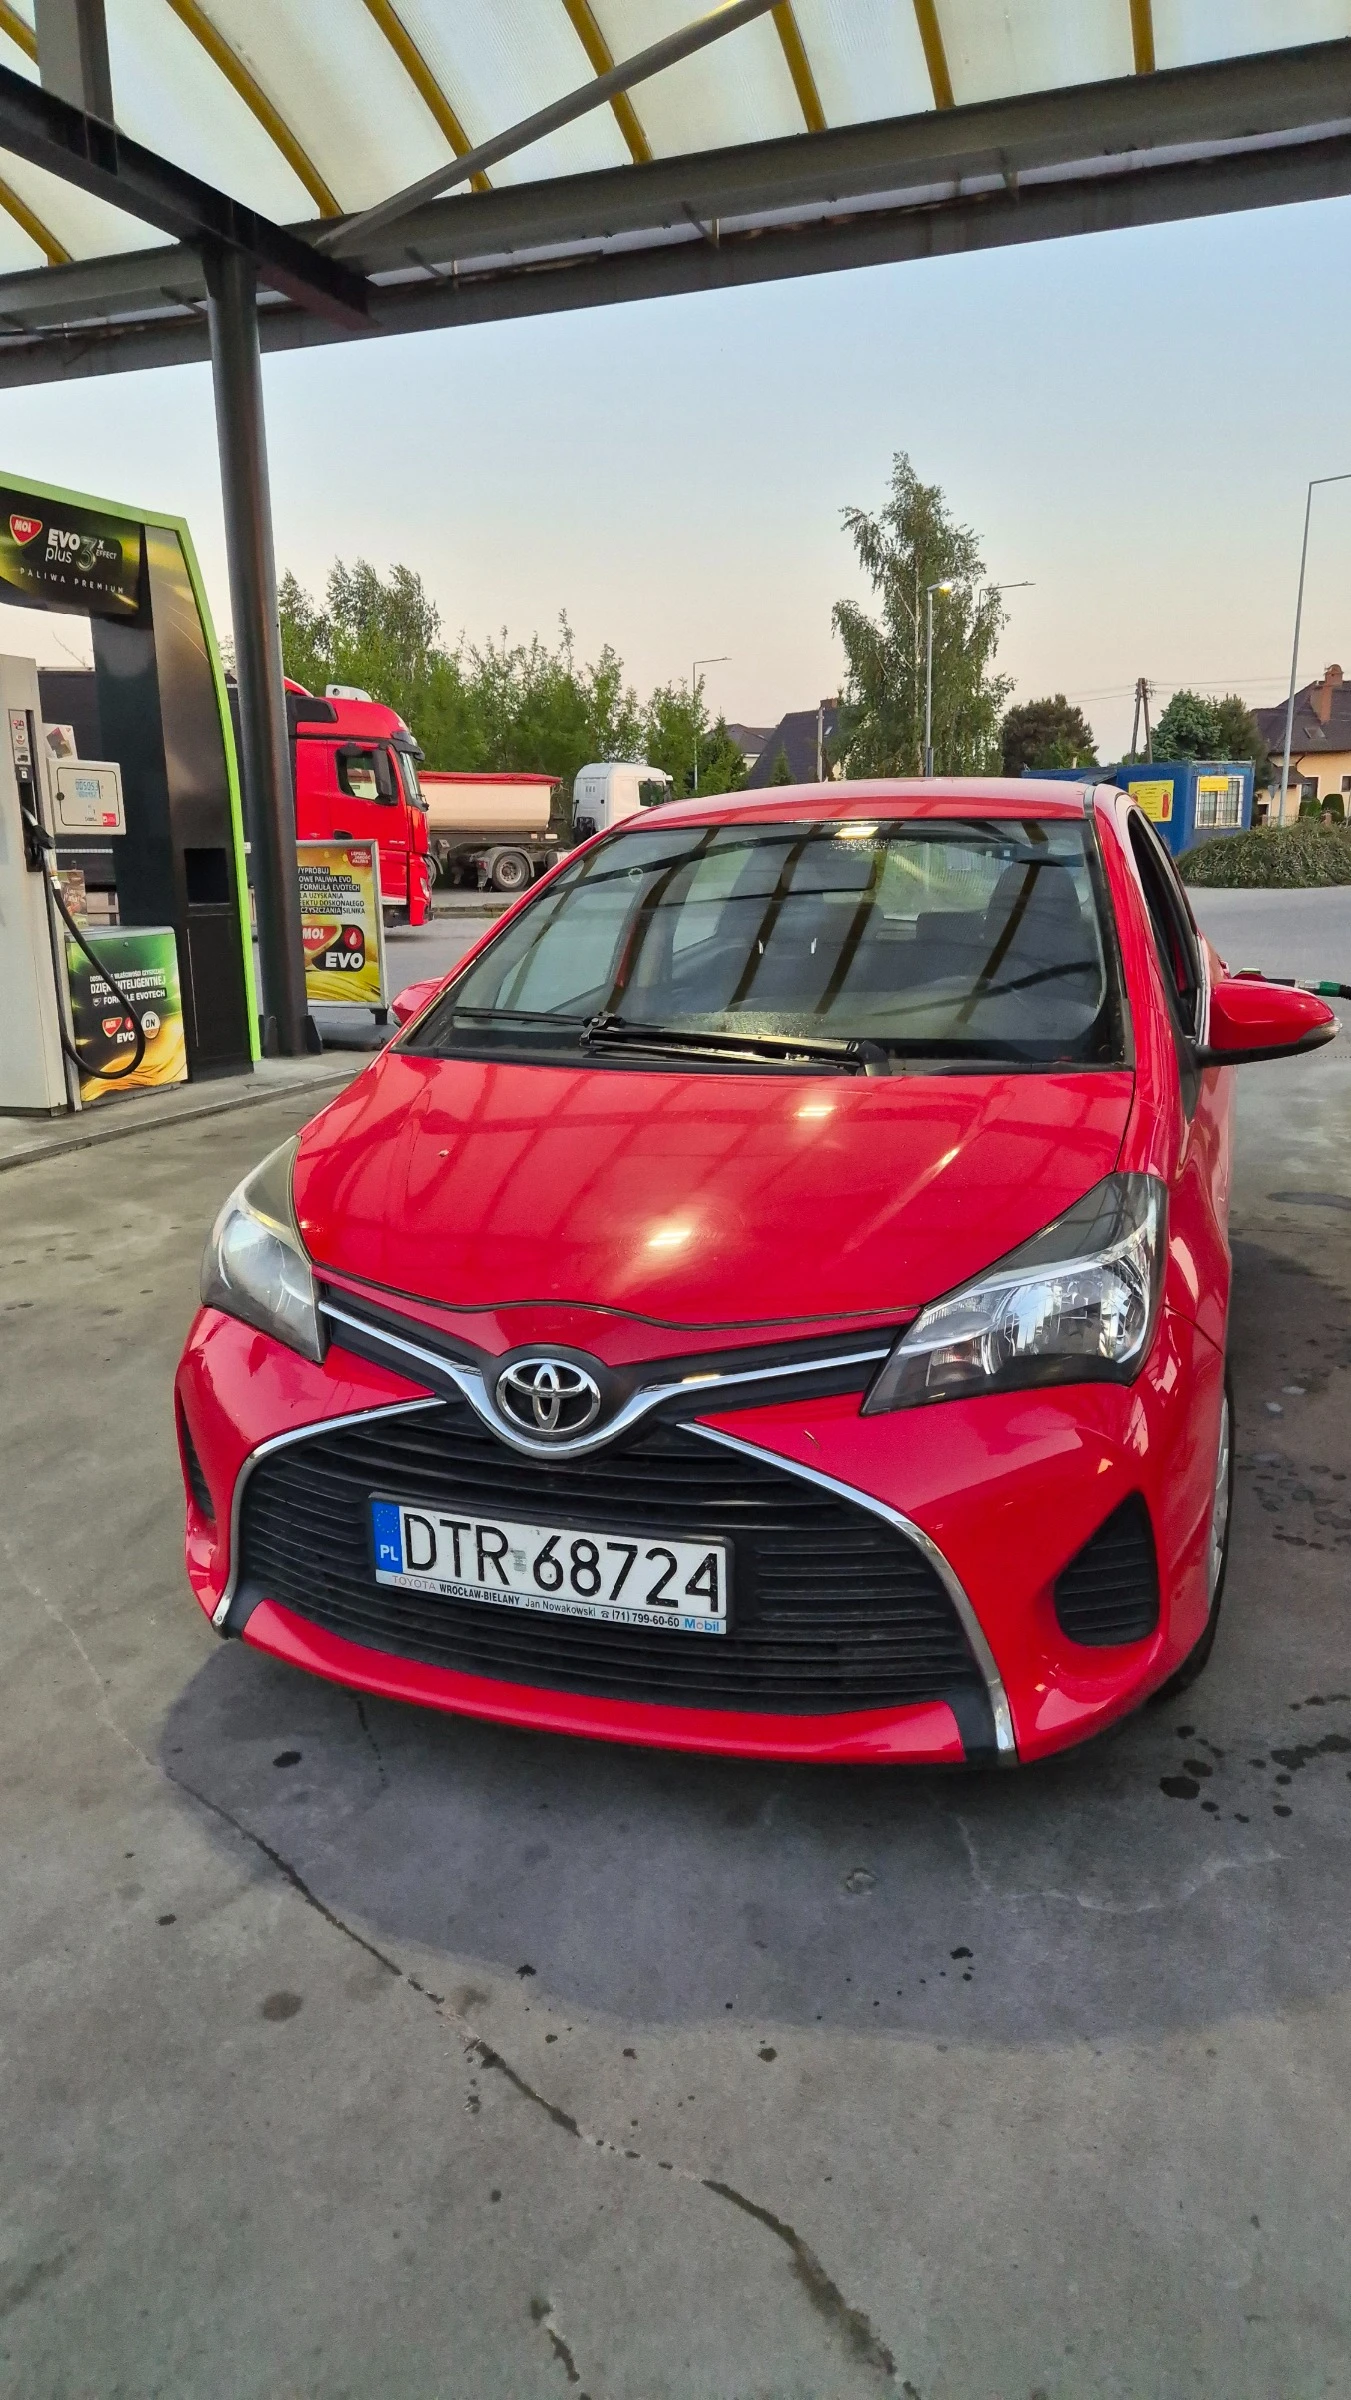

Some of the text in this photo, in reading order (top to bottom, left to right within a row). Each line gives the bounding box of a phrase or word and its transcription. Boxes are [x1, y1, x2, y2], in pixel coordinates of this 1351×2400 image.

[48, 528, 80, 551] EVO
[45, 545, 117, 564] plus EFFECT
[20, 567, 124, 594] PALIWA PREMIUM
[300, 906, 342, 914] CZYSZCZANIA
[302, 927, 325, 940] MOL
[325, 951, 364, 969] EVO
[90, 982, 113, 996] DZIĘK
[136, 989, 166, 1001] EVOTECH
[145, 1019, 156, 1029] ON
[116, 1031, 135, 1044] EVO
[379, 1544, 399, 1562] PL
[403, 1512, 719, 1613] DTR 68724
[391, 1575, 720, 1632] TOYOTA WROCŁAW-BIELANY Jan Nowakowski (71) 799-60-60 Mobil
